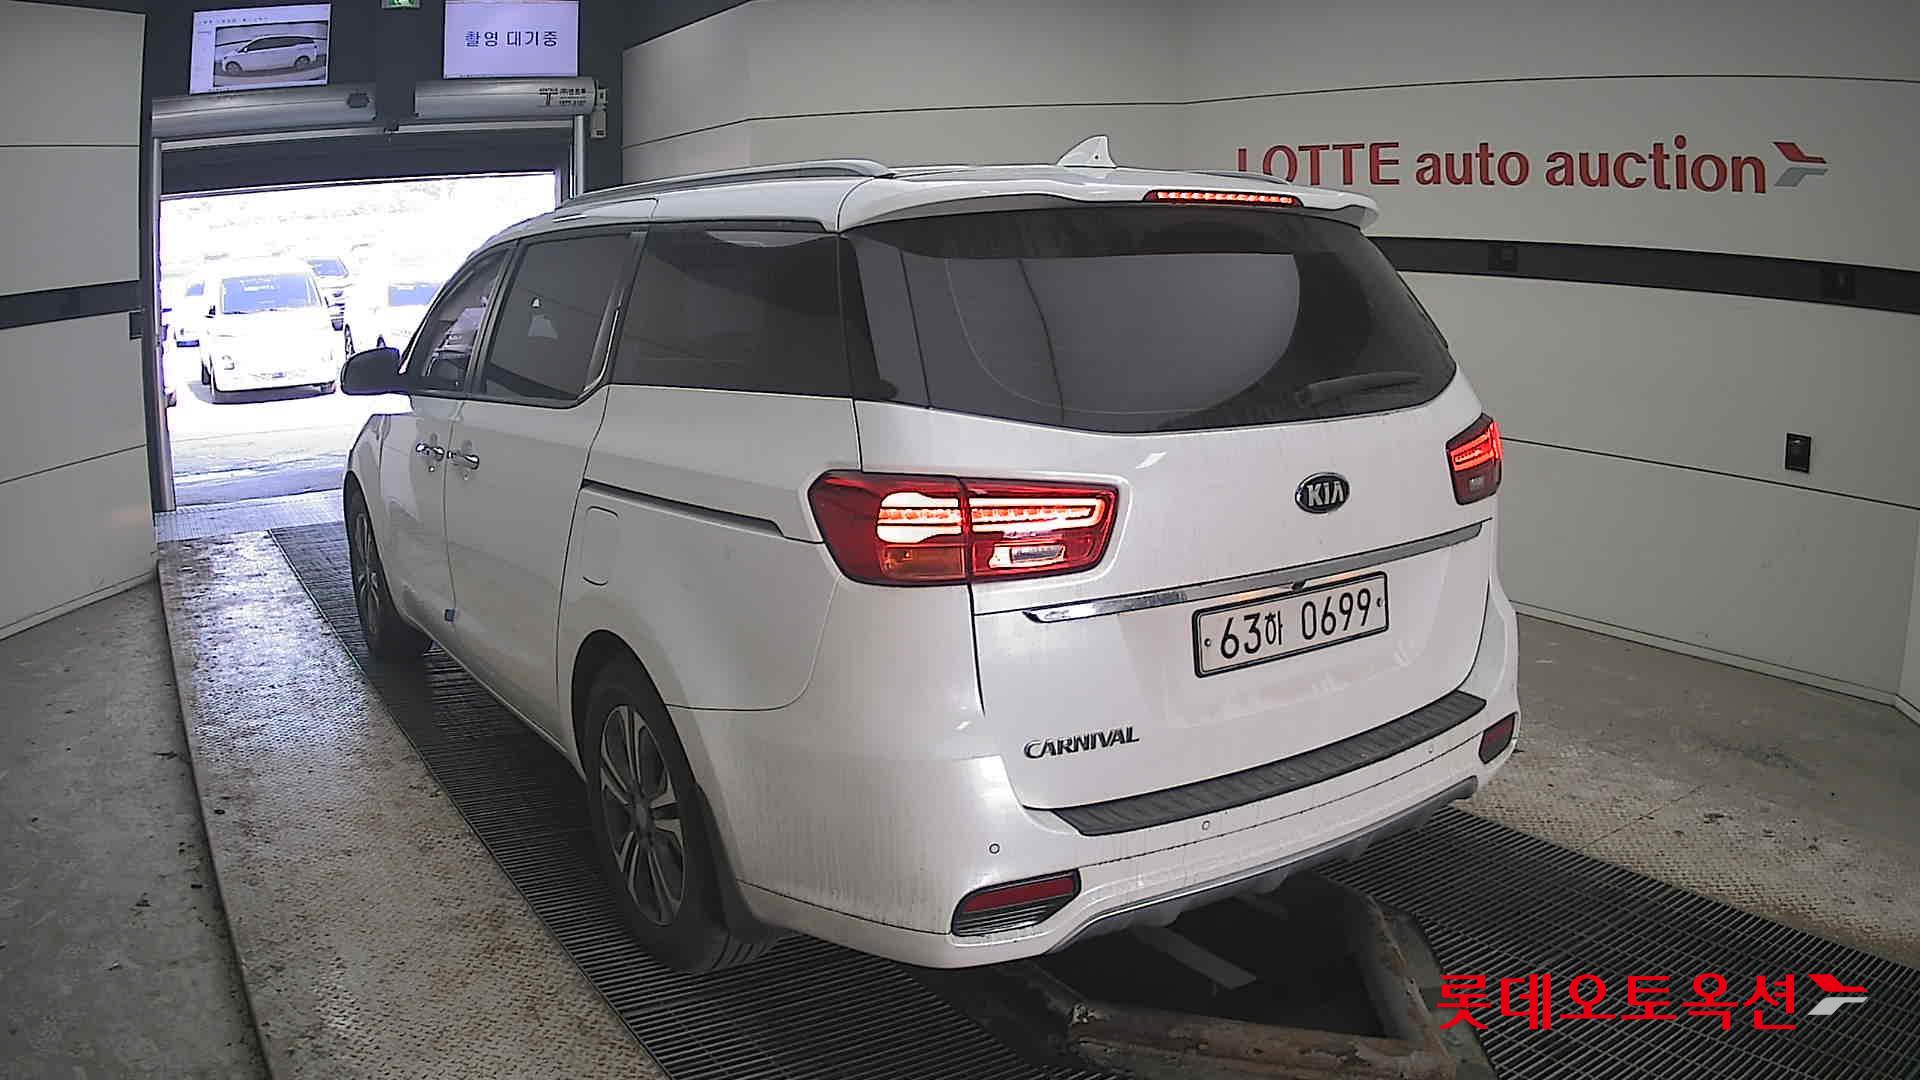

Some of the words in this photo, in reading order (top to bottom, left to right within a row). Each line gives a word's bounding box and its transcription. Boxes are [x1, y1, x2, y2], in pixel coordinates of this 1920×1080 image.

[465, 31, 498, 47] 촬영
[506, 31, 558, 47] 대기중
[1415, 142, 1530, 187] auto
[1544, 135, 1767, 194] auction
[1307, 480, 1344, 506] KIA
[1220, 611, 1283, 659] 63하
[1301, 588, 1371, 640] 0699
[1024, 726, 1140, 759] CARNIVAL
